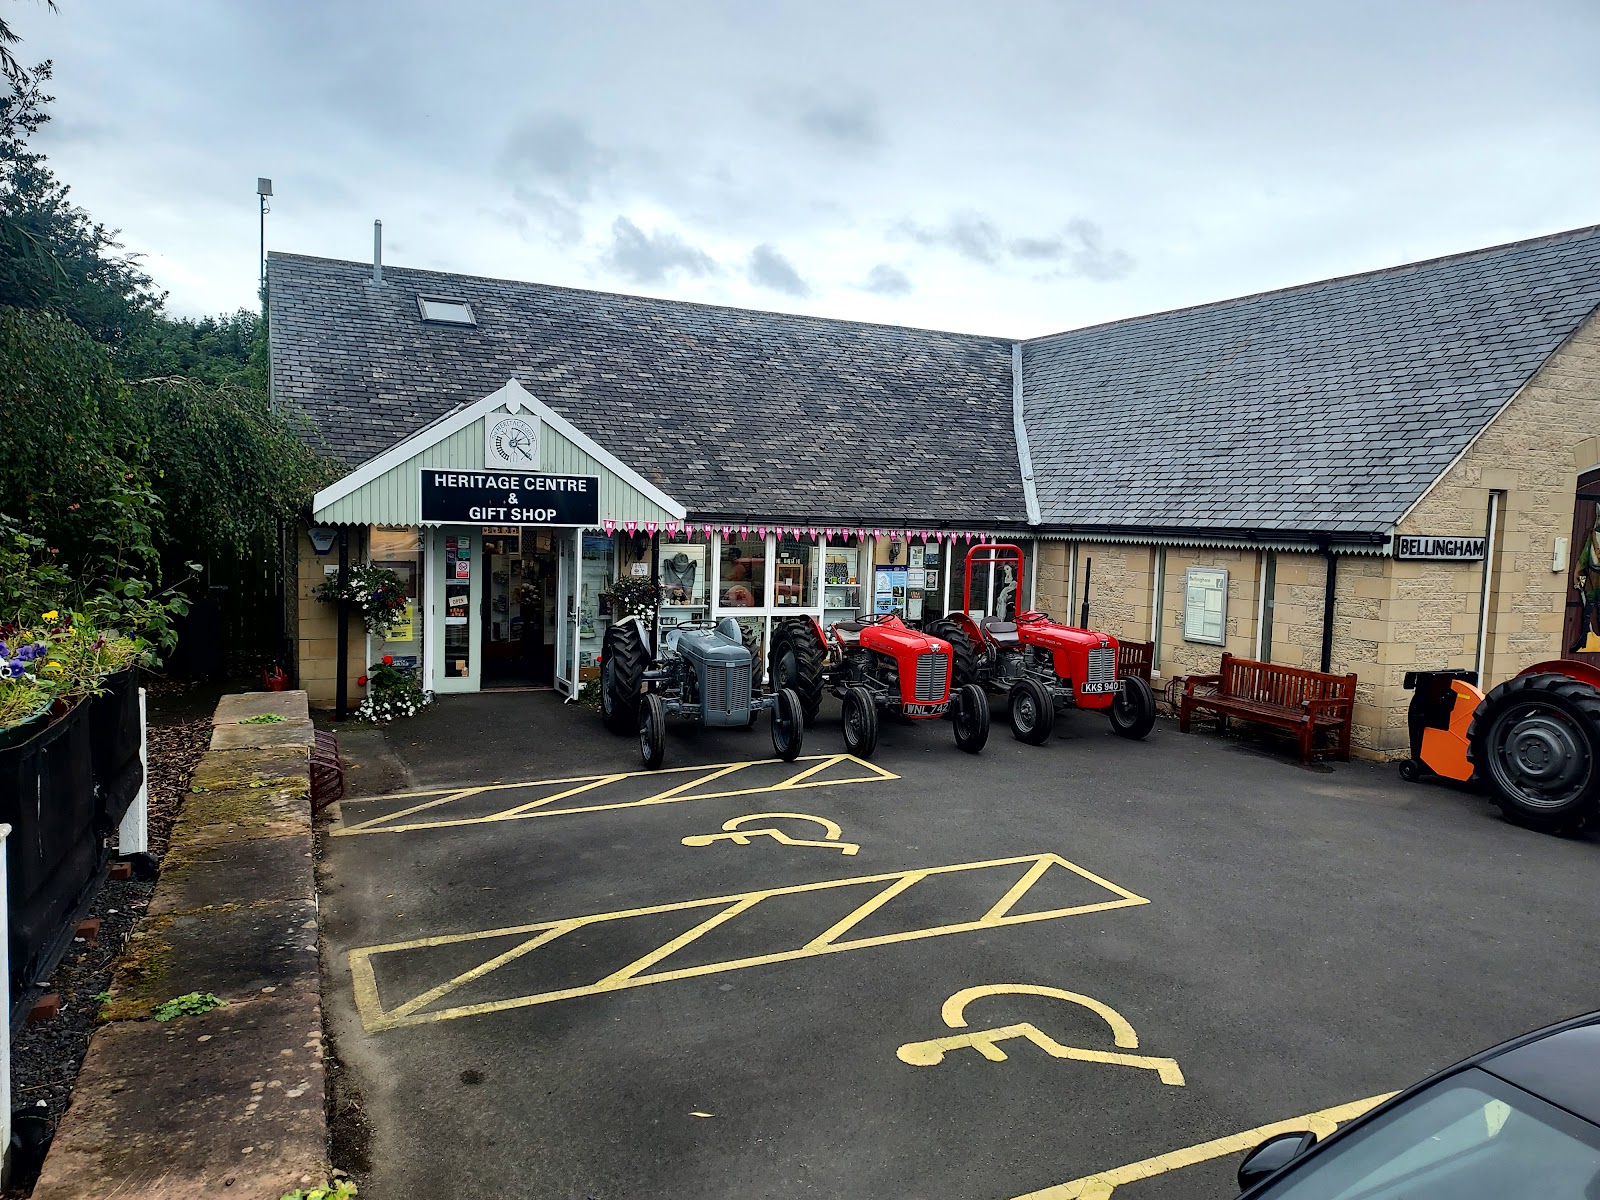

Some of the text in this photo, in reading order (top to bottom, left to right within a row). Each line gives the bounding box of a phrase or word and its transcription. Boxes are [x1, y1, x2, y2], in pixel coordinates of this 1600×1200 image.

[434, 473, 587, 492] HERITAGE CENTRE
[508, 493, 518, 505] &
[469, 507, 557, 521] GIFT SHOP
[1400, 538, 1484, 556] BELLINGHAM
[1085, 682, 1119, 692] KKS 940
[907, 703, 948, 715] WNL 742
